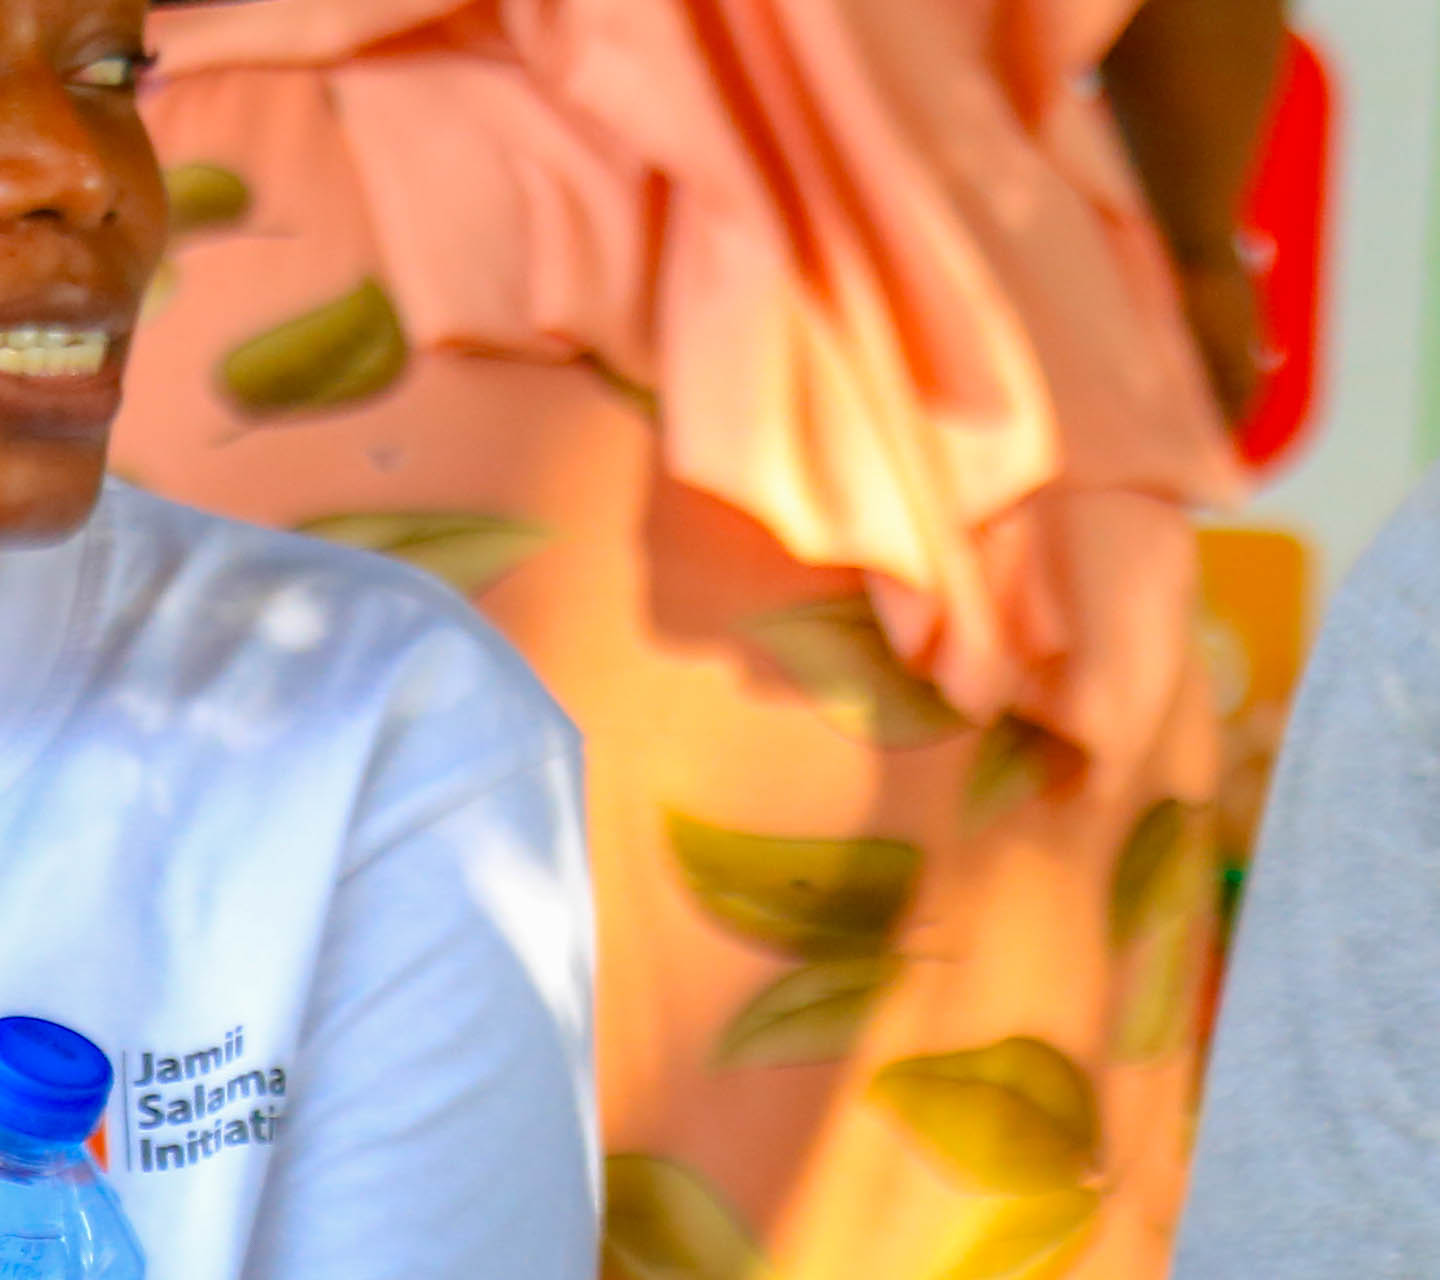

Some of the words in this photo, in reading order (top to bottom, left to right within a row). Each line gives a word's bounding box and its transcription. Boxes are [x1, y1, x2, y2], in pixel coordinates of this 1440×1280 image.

[134, 1025, 243, 1086] Jamii
[138, 1067, 286, 1130] Salama
[140, 1106, 280, 1173] Initiati
